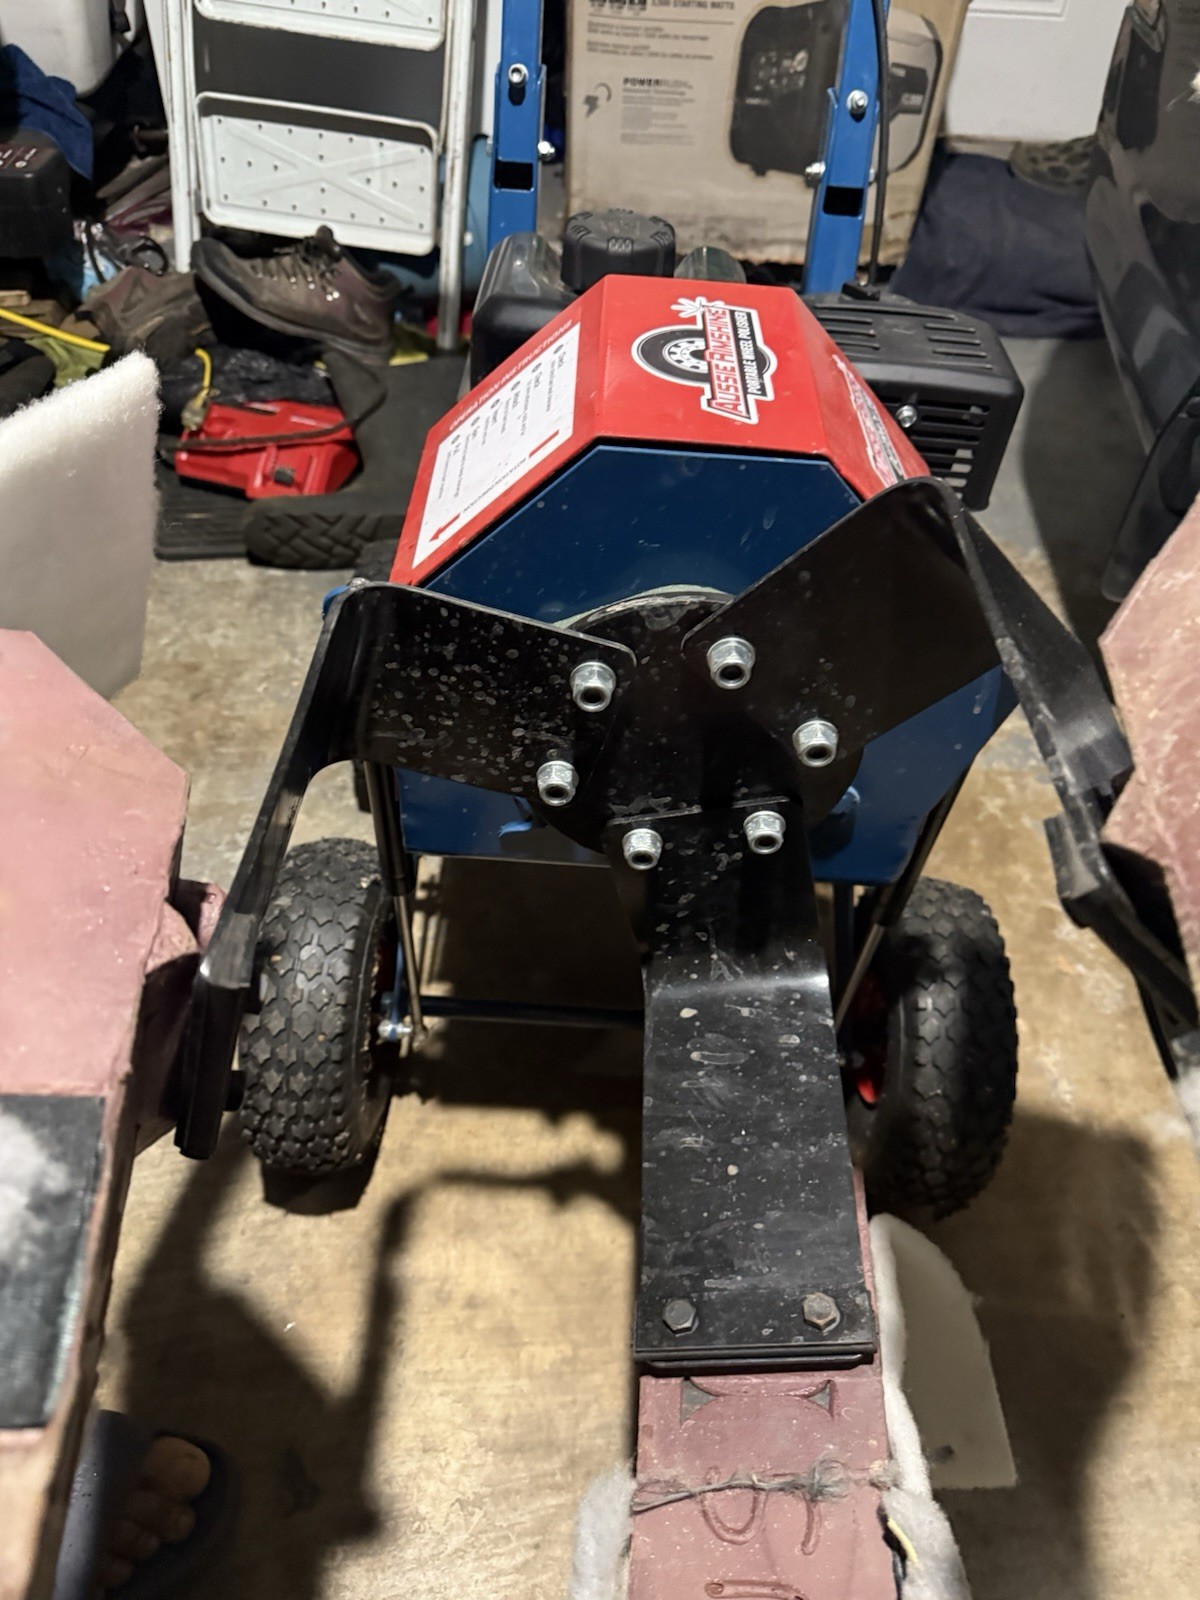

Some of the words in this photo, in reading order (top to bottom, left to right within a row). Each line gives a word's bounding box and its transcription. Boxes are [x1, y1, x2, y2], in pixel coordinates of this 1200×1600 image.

[707, 307, 735, 364] RIMSHINE
[734, 311, 752, 340] POLISHER
[739, 340, 755, 361] WHEEL
[713, 363, 743, 414] AUSSIE
[742, 360, 762, 394] PORTABLE
